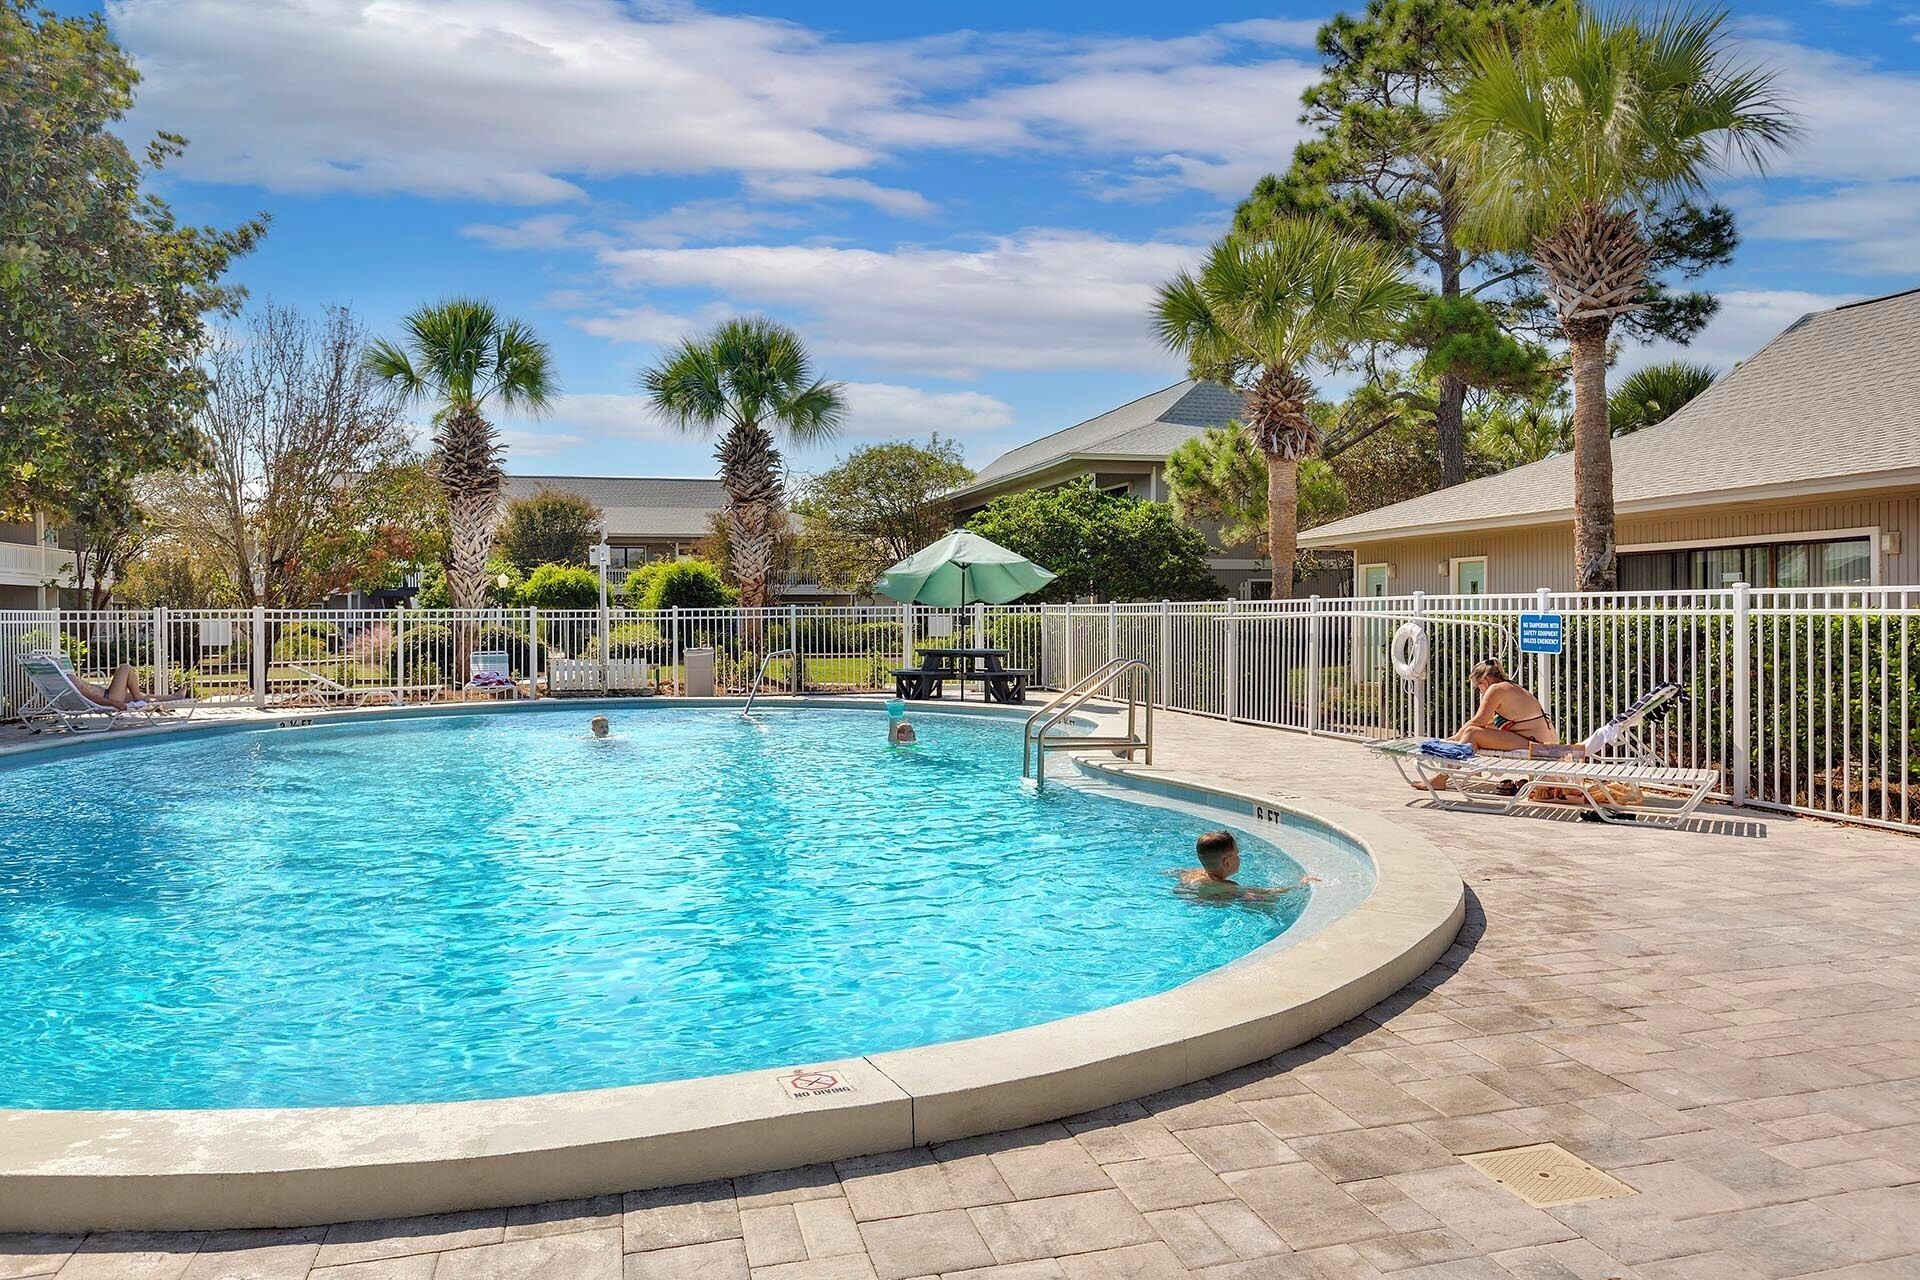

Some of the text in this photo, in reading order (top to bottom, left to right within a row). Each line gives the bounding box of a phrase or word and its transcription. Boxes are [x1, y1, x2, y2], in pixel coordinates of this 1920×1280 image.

[1257, 806, 1280, 825] 6 FT
[813, 1086, 851, 1096] DIVING
